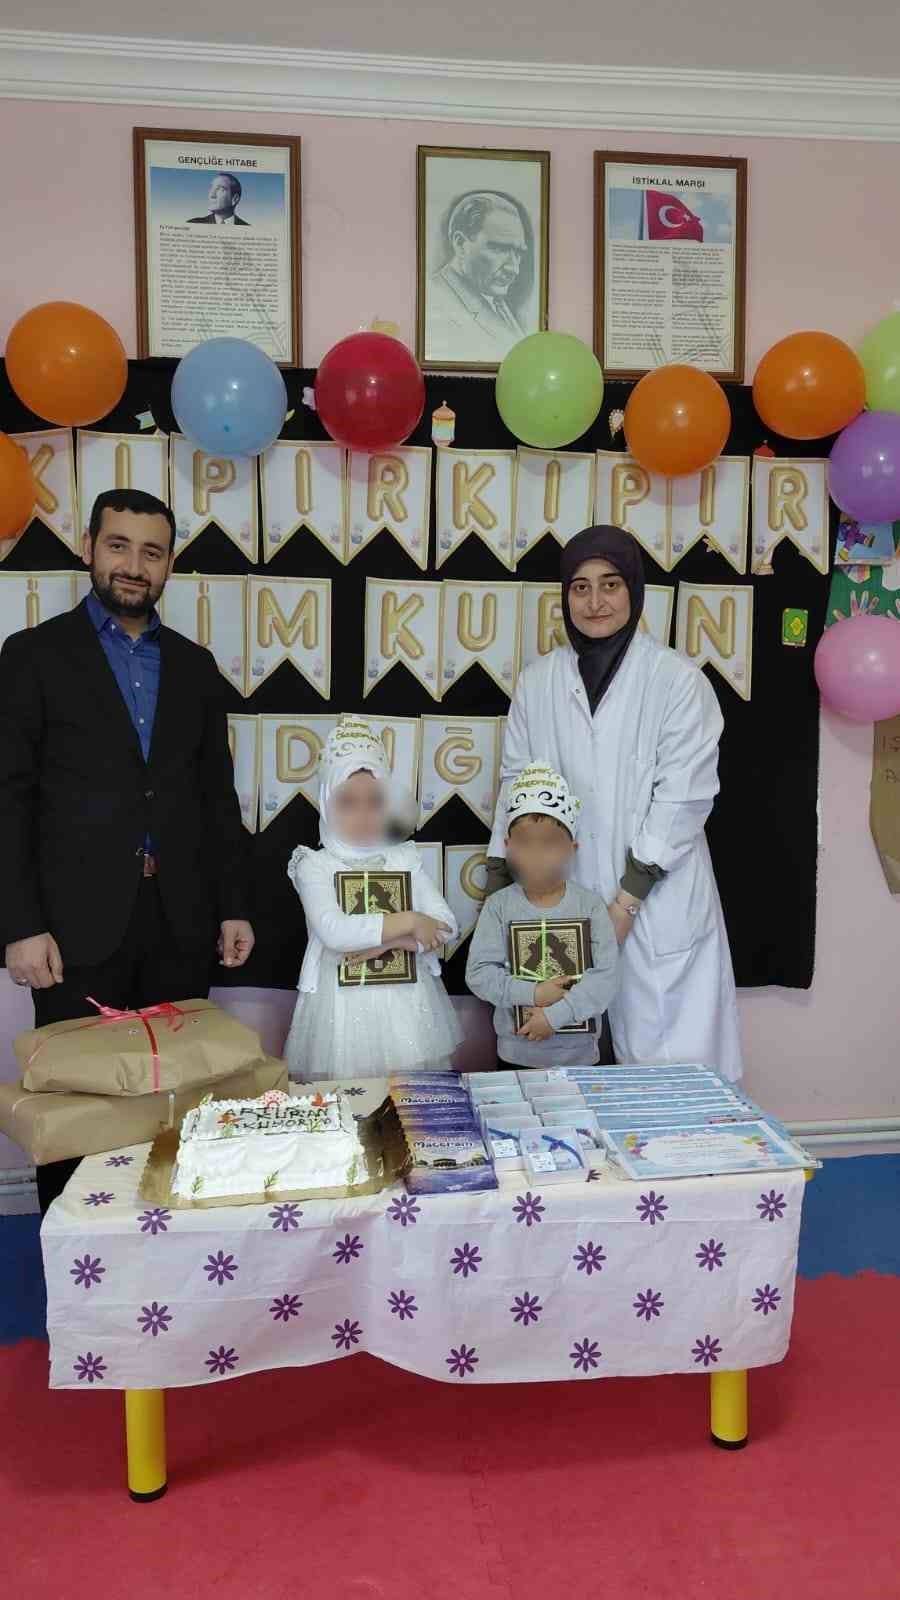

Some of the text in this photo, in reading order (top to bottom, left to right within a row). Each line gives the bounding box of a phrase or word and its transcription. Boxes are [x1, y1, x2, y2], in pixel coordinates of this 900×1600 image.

[675, 178, 705, 189] MARŞI
[26, 576, 736, 660] İİM KURN
